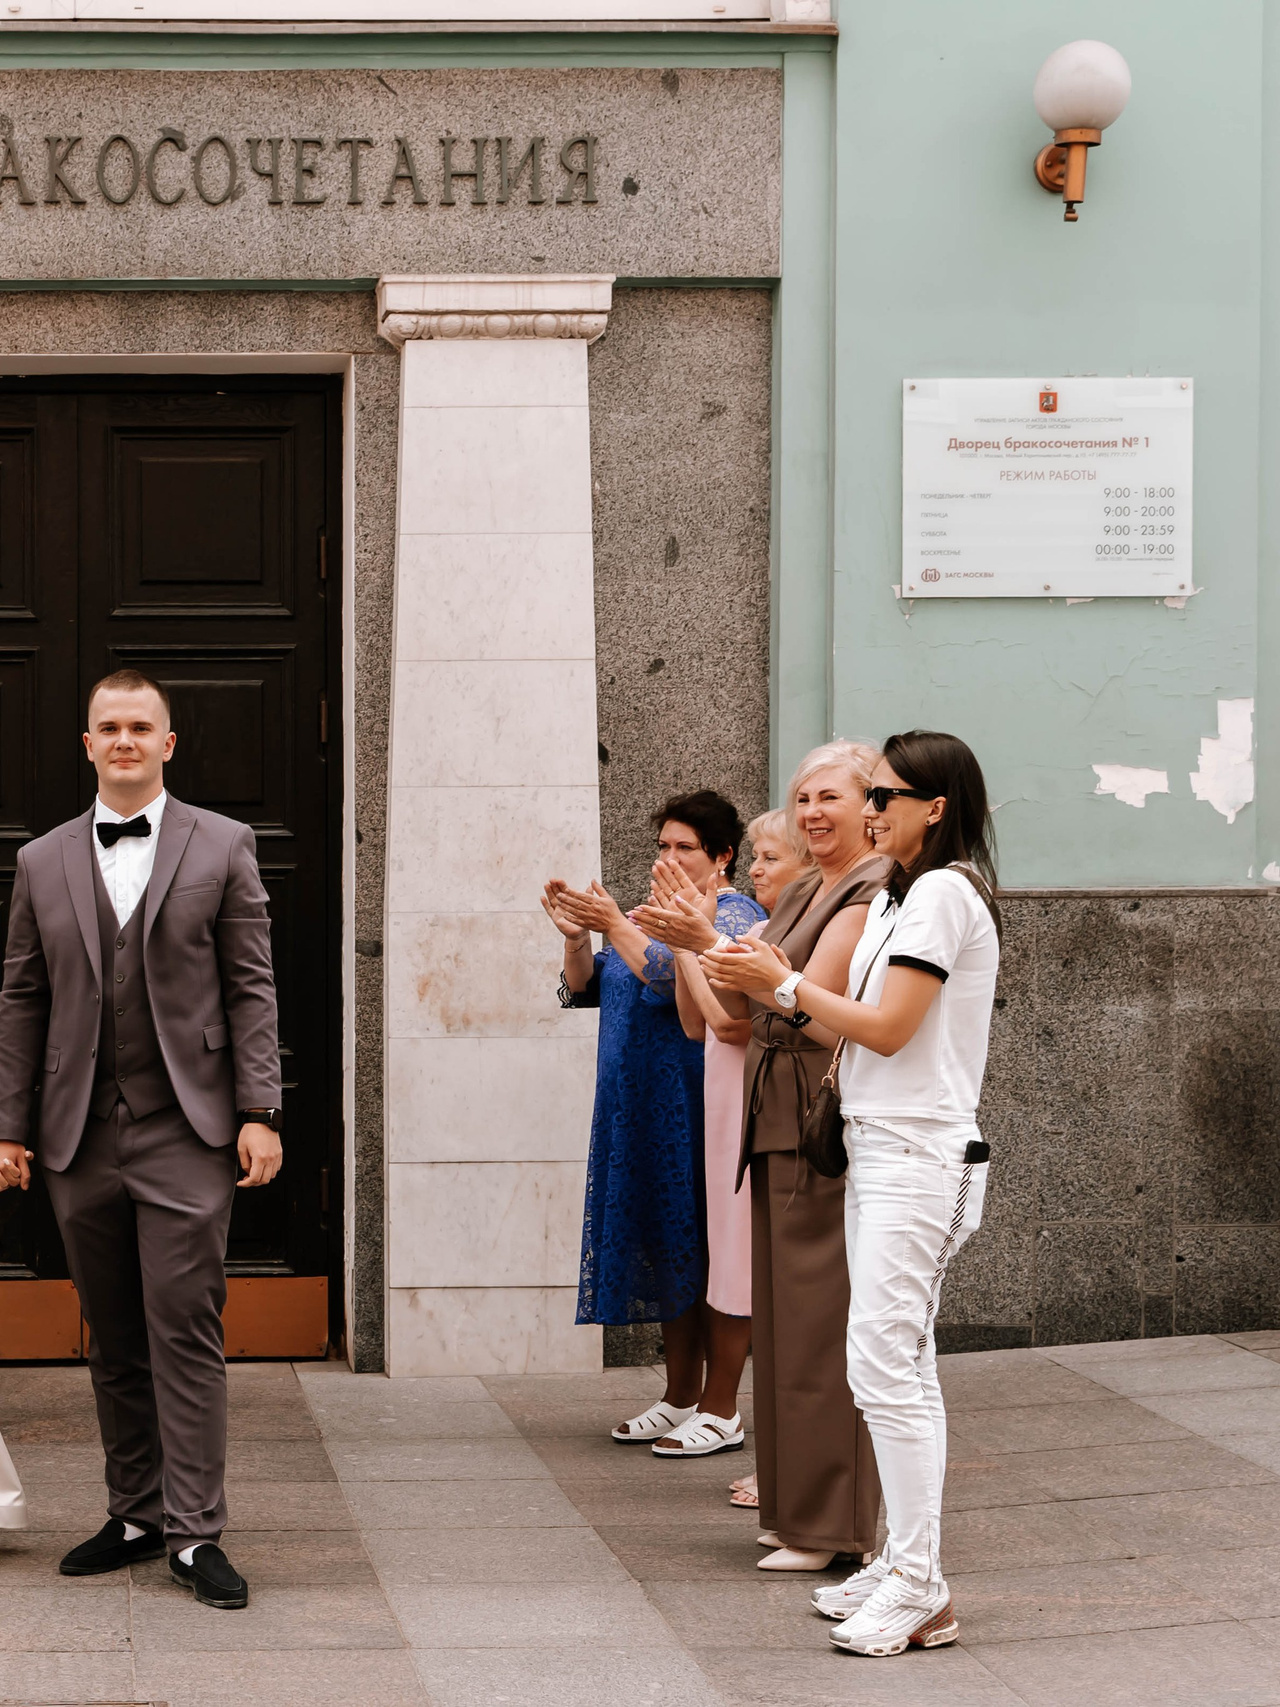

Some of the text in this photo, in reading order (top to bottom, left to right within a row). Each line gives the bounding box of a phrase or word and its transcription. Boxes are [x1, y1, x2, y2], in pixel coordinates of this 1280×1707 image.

[947, 436, 1150, 452] Дворец бракосочетания № 1
[999, 470, 1097, 481] РЕЖИМ РАБОТЫ
[1103, 487, 1131, 498] 9:00
[1143, 487, 1175, 498] 18:00
[1103, 506, 1131, 517] 9:00
[1140, 505, 1175, 517] 20:00
[1103, 525, 1130, 536] 9:00
[1140, 524, 1175, 536] 23:59
[1095, 544, 1130, 555] 00:00
[1142, 543, 1175, 555] 19:00
